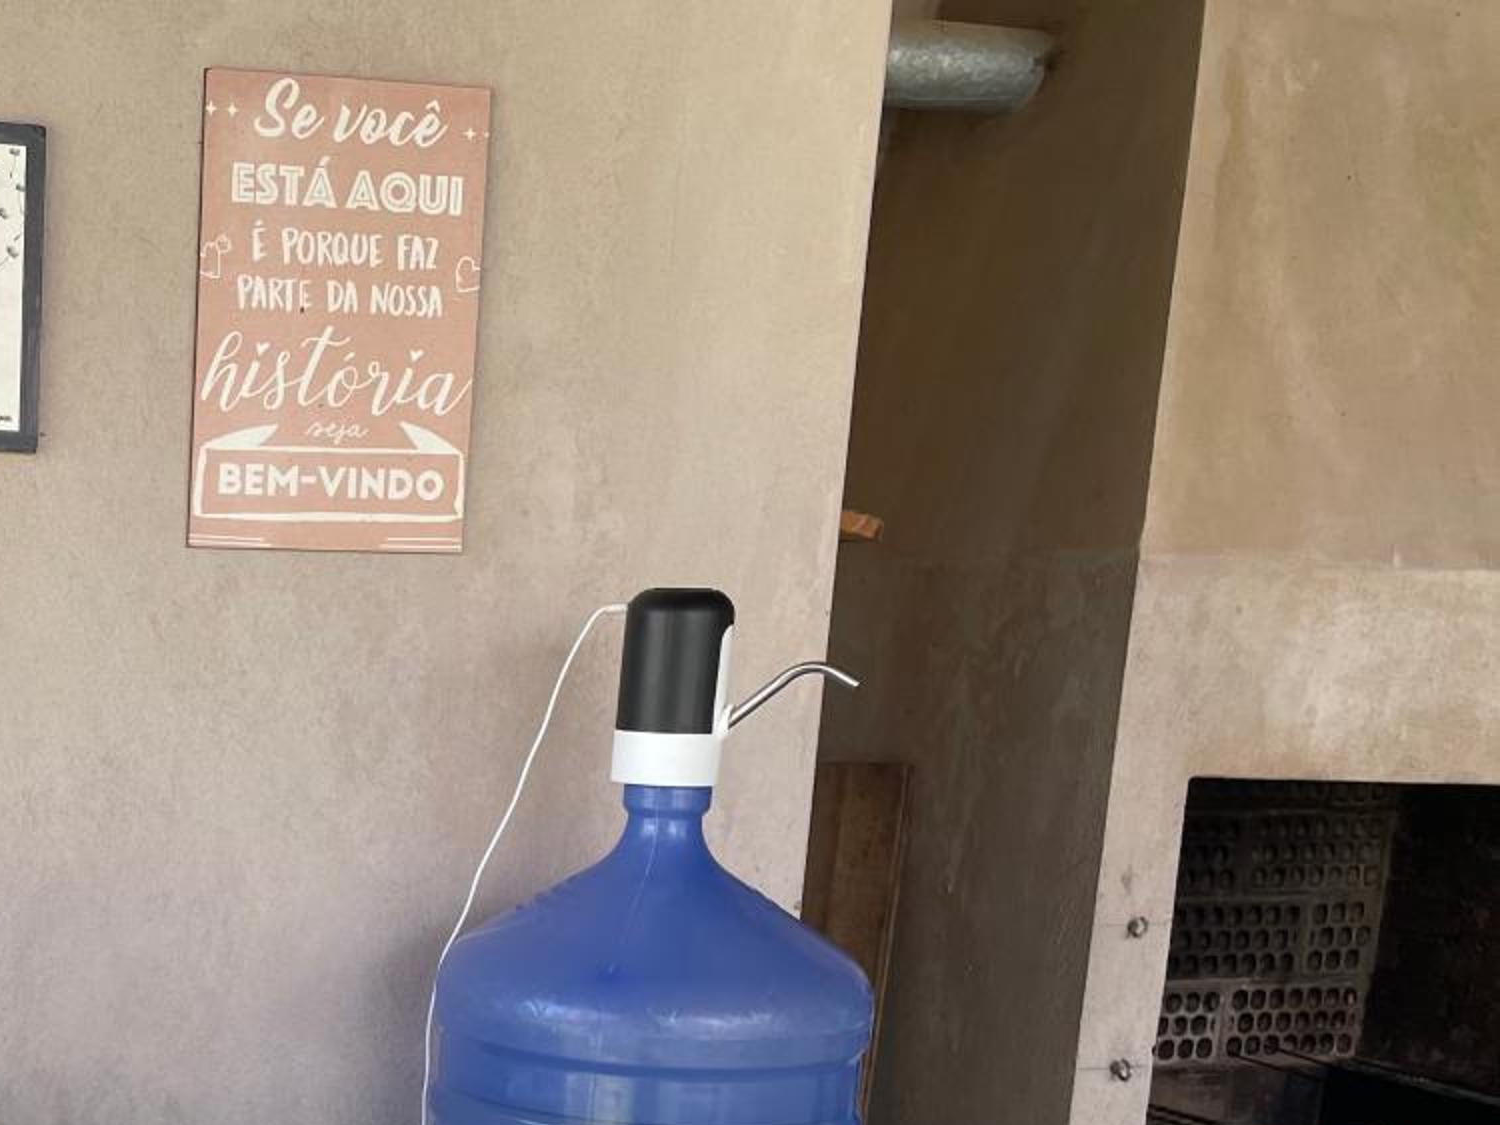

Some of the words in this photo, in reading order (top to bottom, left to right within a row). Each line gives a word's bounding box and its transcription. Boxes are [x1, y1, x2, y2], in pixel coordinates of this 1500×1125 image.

[254, 78, 325, 139] Se
[332, 100, 449, 148] você
[231, 155, 337, 209] ESTÁ
[346, 170, 464, 217] AQUI
[252, 219, 267, 263] É
[281, 226, 383, 268] PORQUE
[397, 233, 439, 271] FAZ
[237, 273, 313, 310] PARTE
[327, 278, 358, 314] DA
[370, 283, 443, 318] NOSSA
[200, 325, 473, 416] história
[306, 421, 369, 445] seja
[217, 461, 446, 501] BEM-VINDO
